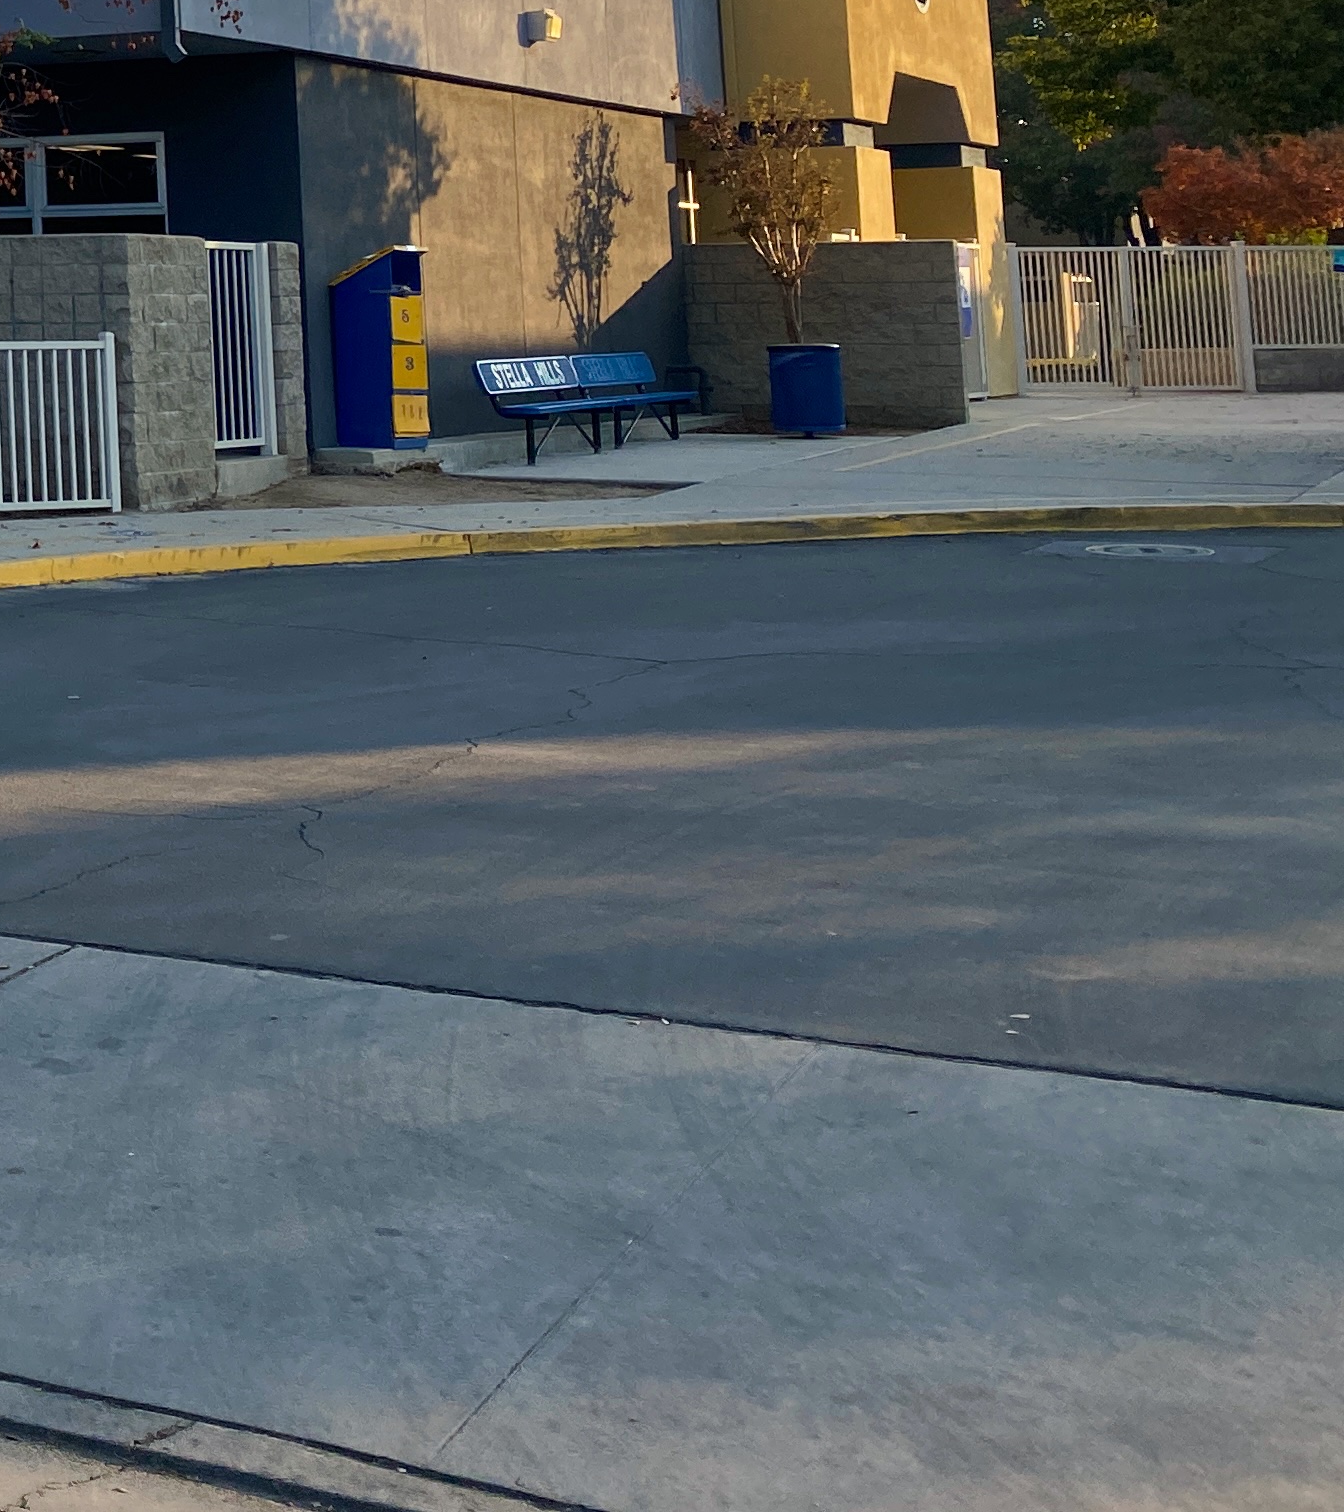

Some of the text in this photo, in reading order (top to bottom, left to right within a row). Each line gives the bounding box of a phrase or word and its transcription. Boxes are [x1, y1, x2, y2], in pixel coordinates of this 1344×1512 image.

[405, 356, 415, 371] 3
[490, 360, 566, 389] STELLA HILLS
